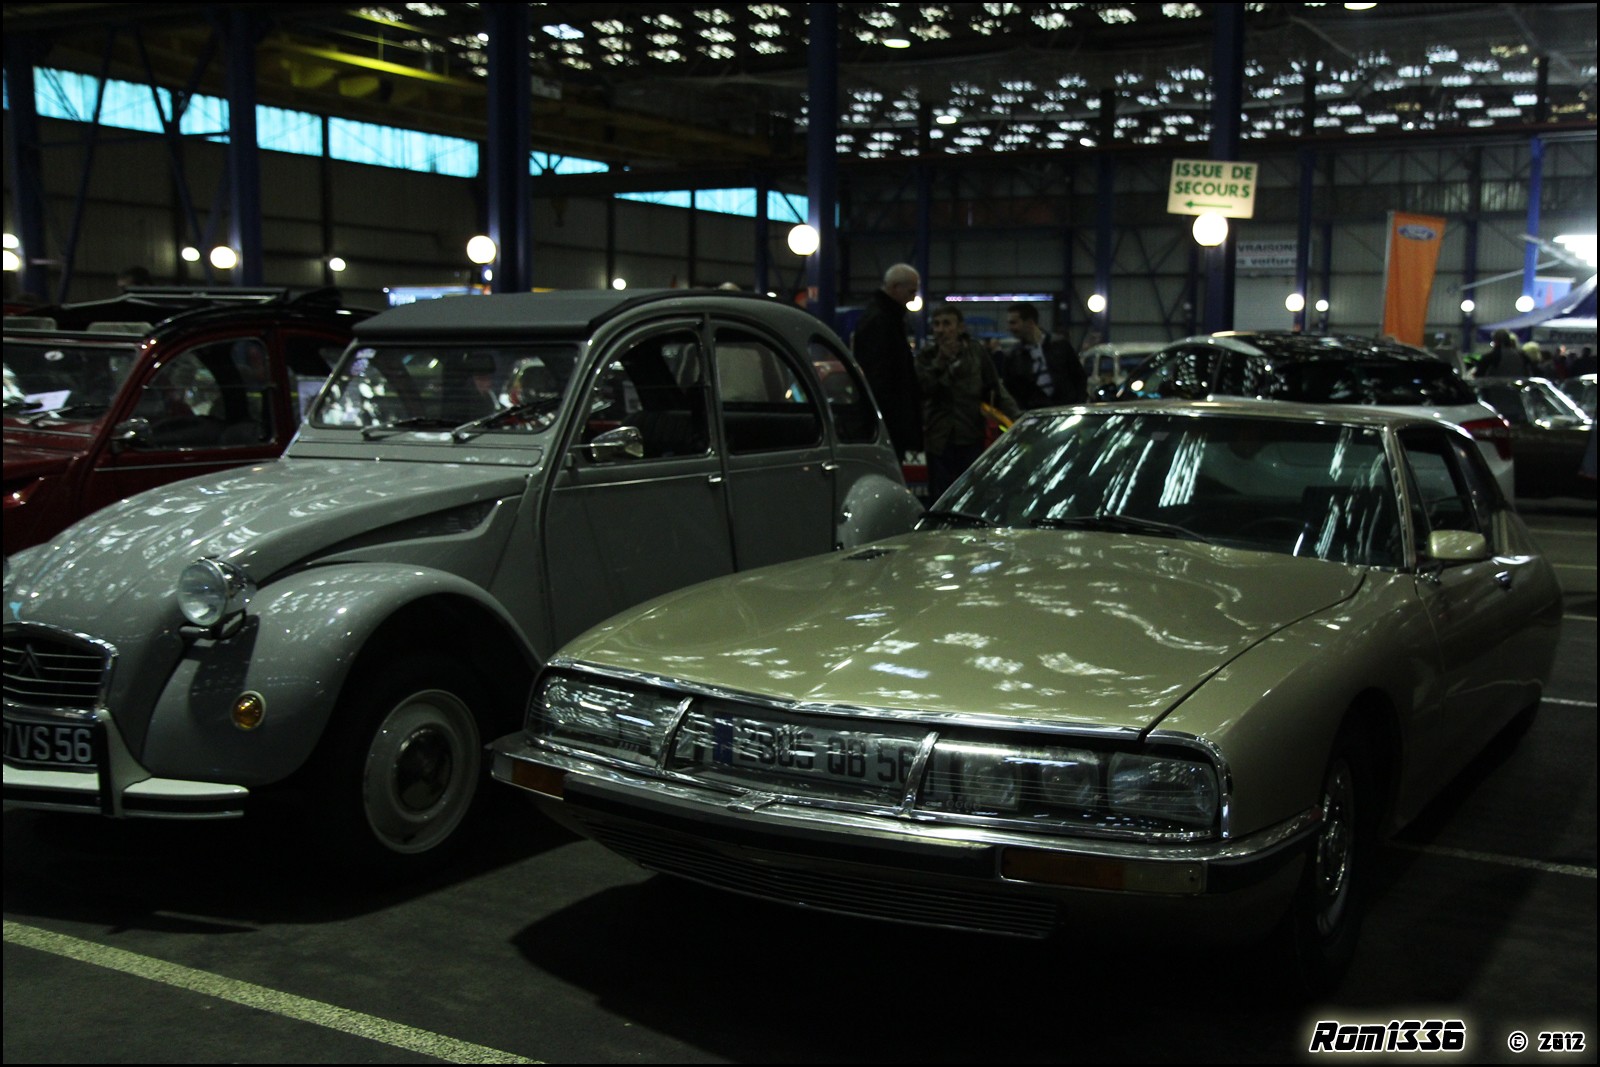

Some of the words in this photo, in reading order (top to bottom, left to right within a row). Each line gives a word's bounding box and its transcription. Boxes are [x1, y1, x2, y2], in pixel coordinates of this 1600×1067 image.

[1175, 162, 1224, 179] ISSUE
[1231, 165, 1253, 180] DE
[1173, 180, 1250, 198] SECOURS
[1238, 243, 1296, 252] VRAISON
[827, 736, 866, 778] QB
[877, 740, 915, 784] 56
